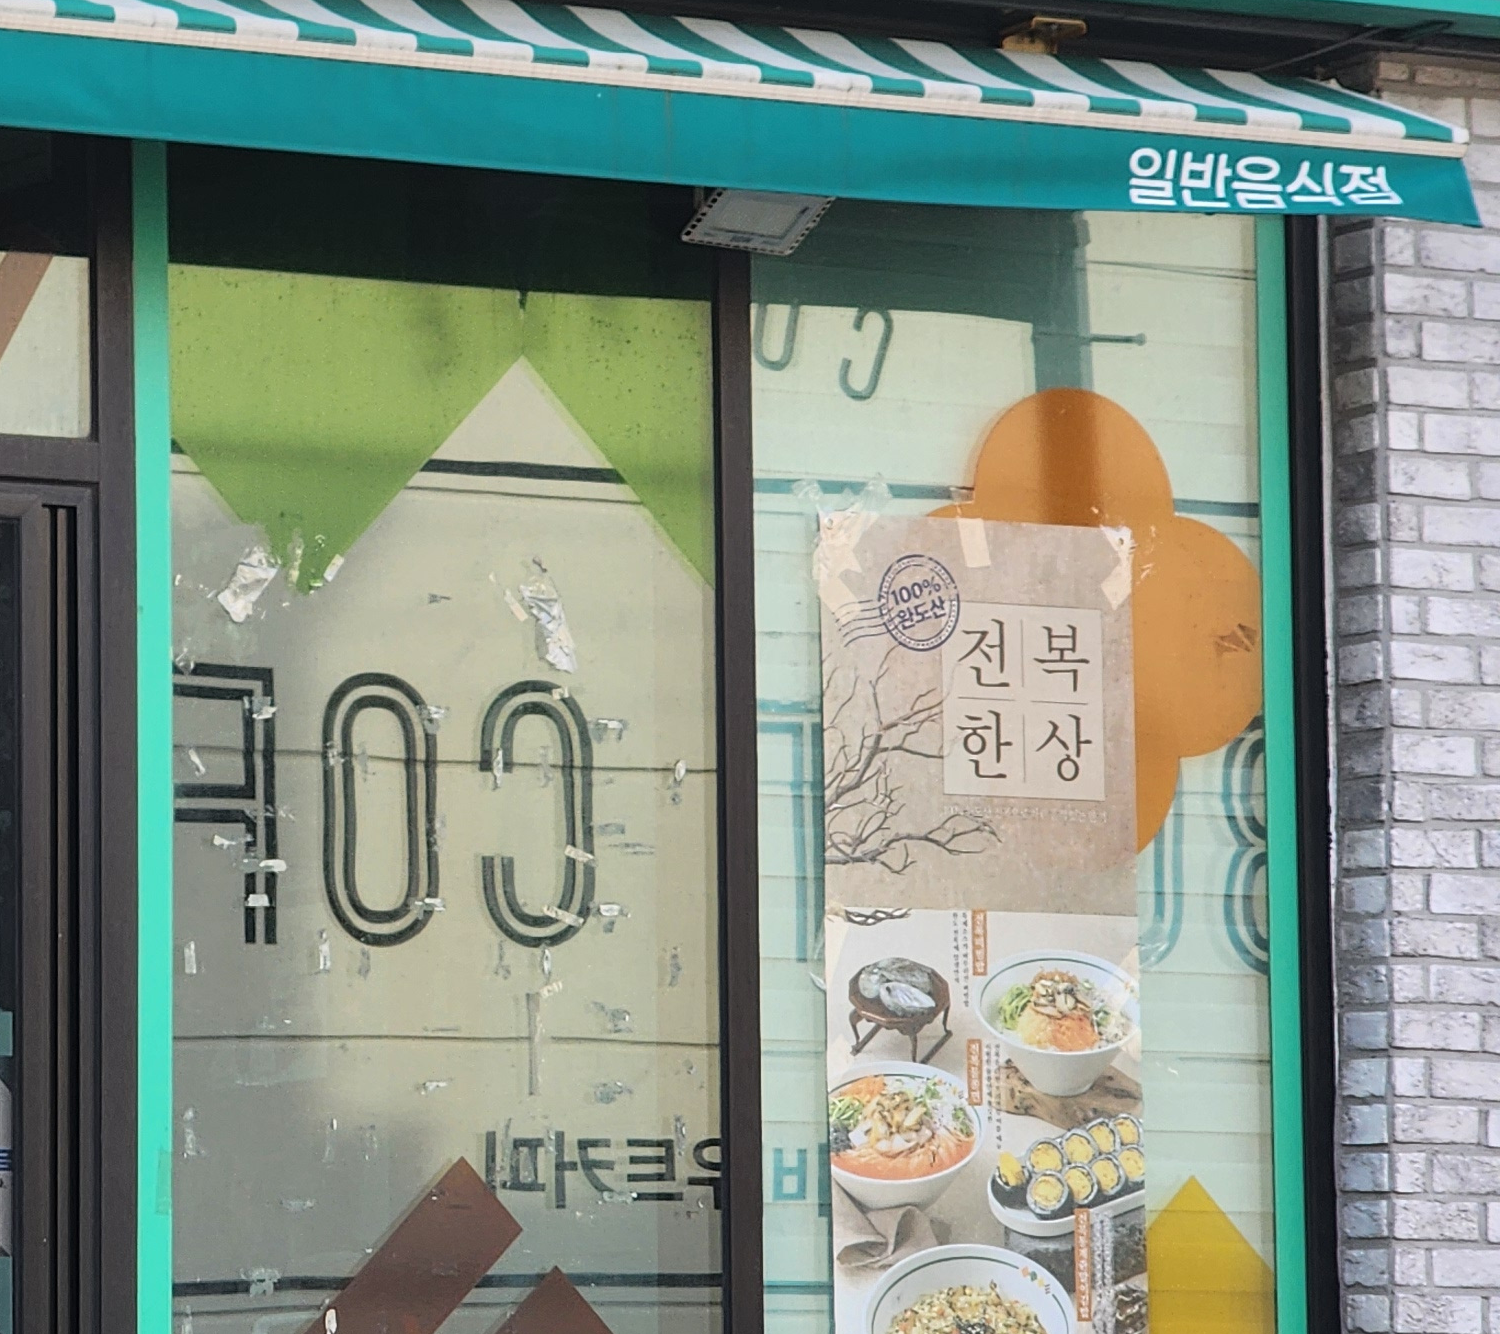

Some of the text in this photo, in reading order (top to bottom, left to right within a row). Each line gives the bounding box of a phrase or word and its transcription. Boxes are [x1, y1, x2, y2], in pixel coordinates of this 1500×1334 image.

[1129, 147, 1403, 208] 일반음식점
[891, 576, 942, 606] 100%
[957, 619, 1091, 693] 전복
[956, 710, 1093, 782] 한상
